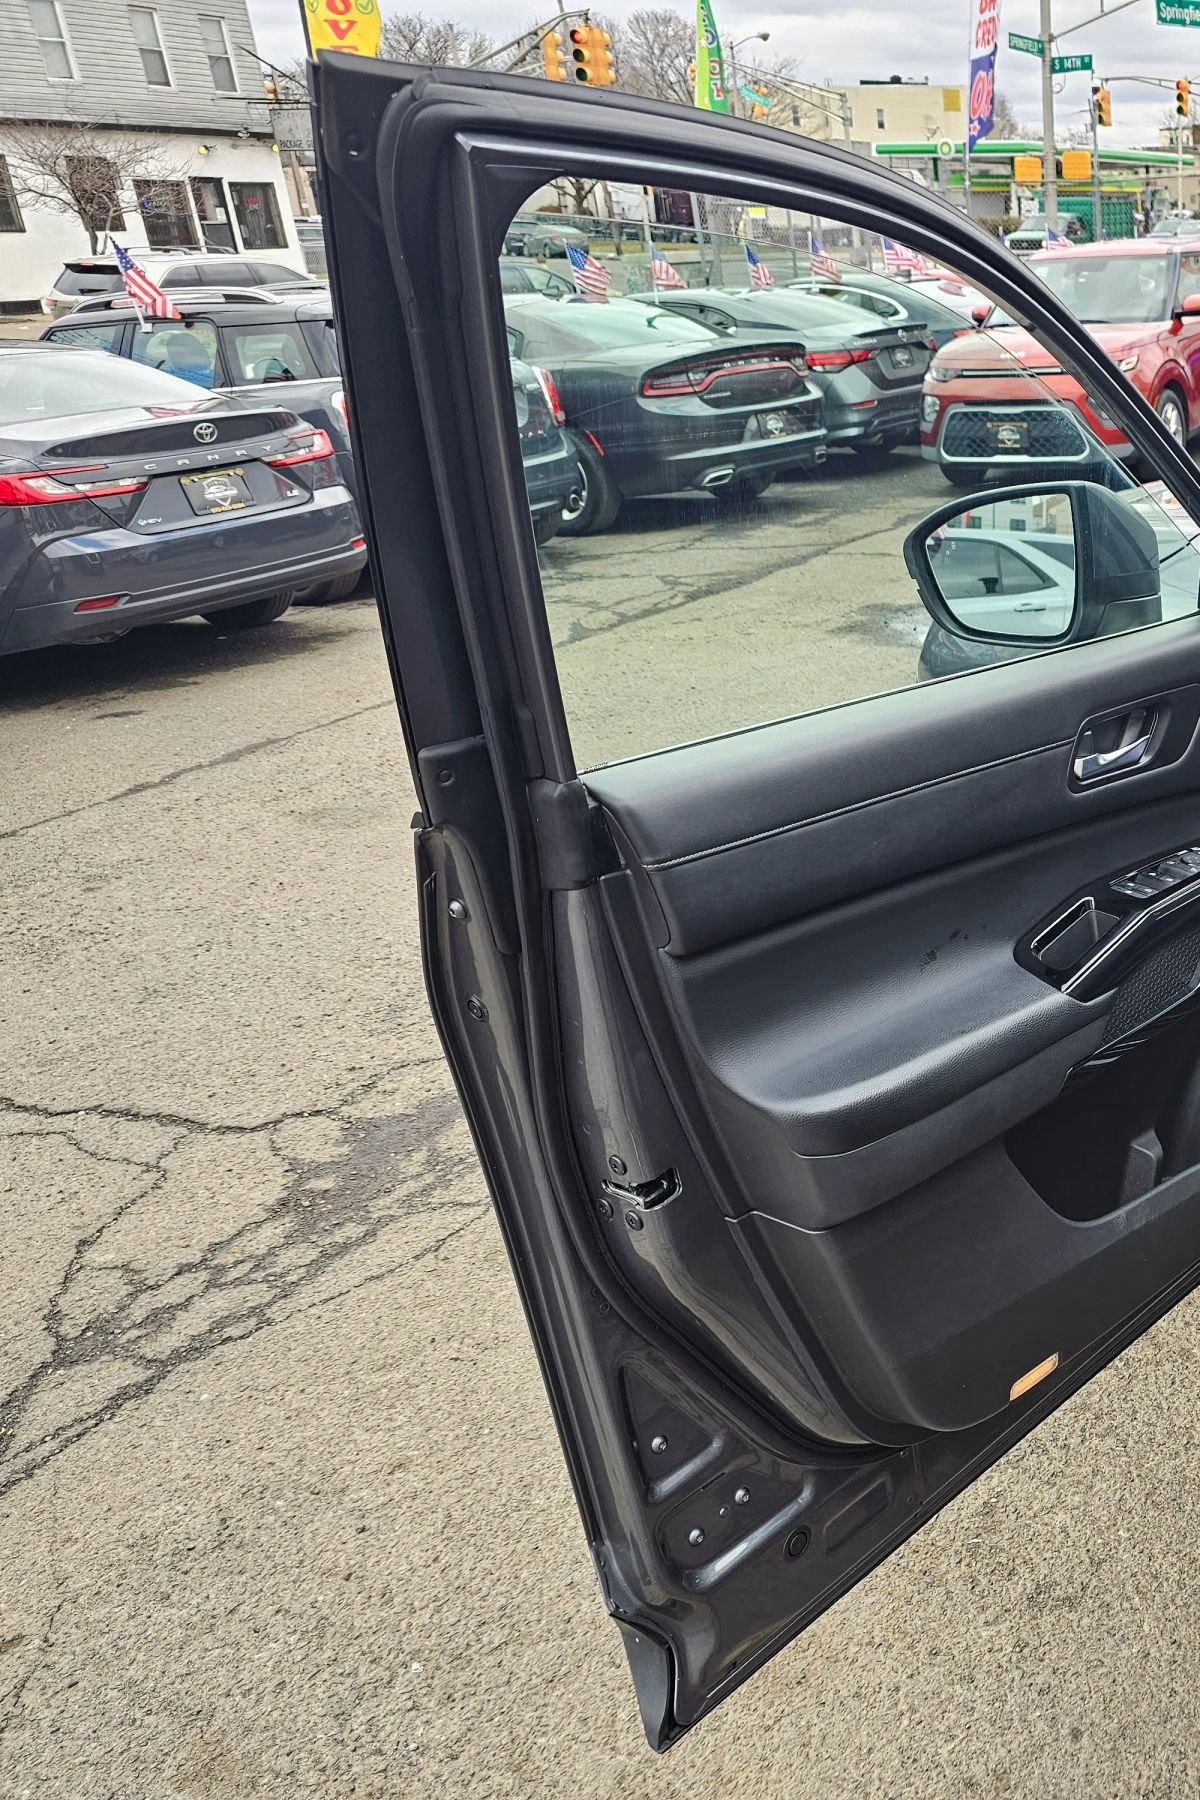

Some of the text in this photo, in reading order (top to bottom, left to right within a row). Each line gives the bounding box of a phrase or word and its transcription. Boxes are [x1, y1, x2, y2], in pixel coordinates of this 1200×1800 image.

[323, 0, 359, 52] OV
[1009, 35, 1038, 52] SPRINGFIELD
[1054, 59, 1060, 70] S
[1064, 58, 1081, 70] 14TH
[144, 445, 272, 471] CAMRY
